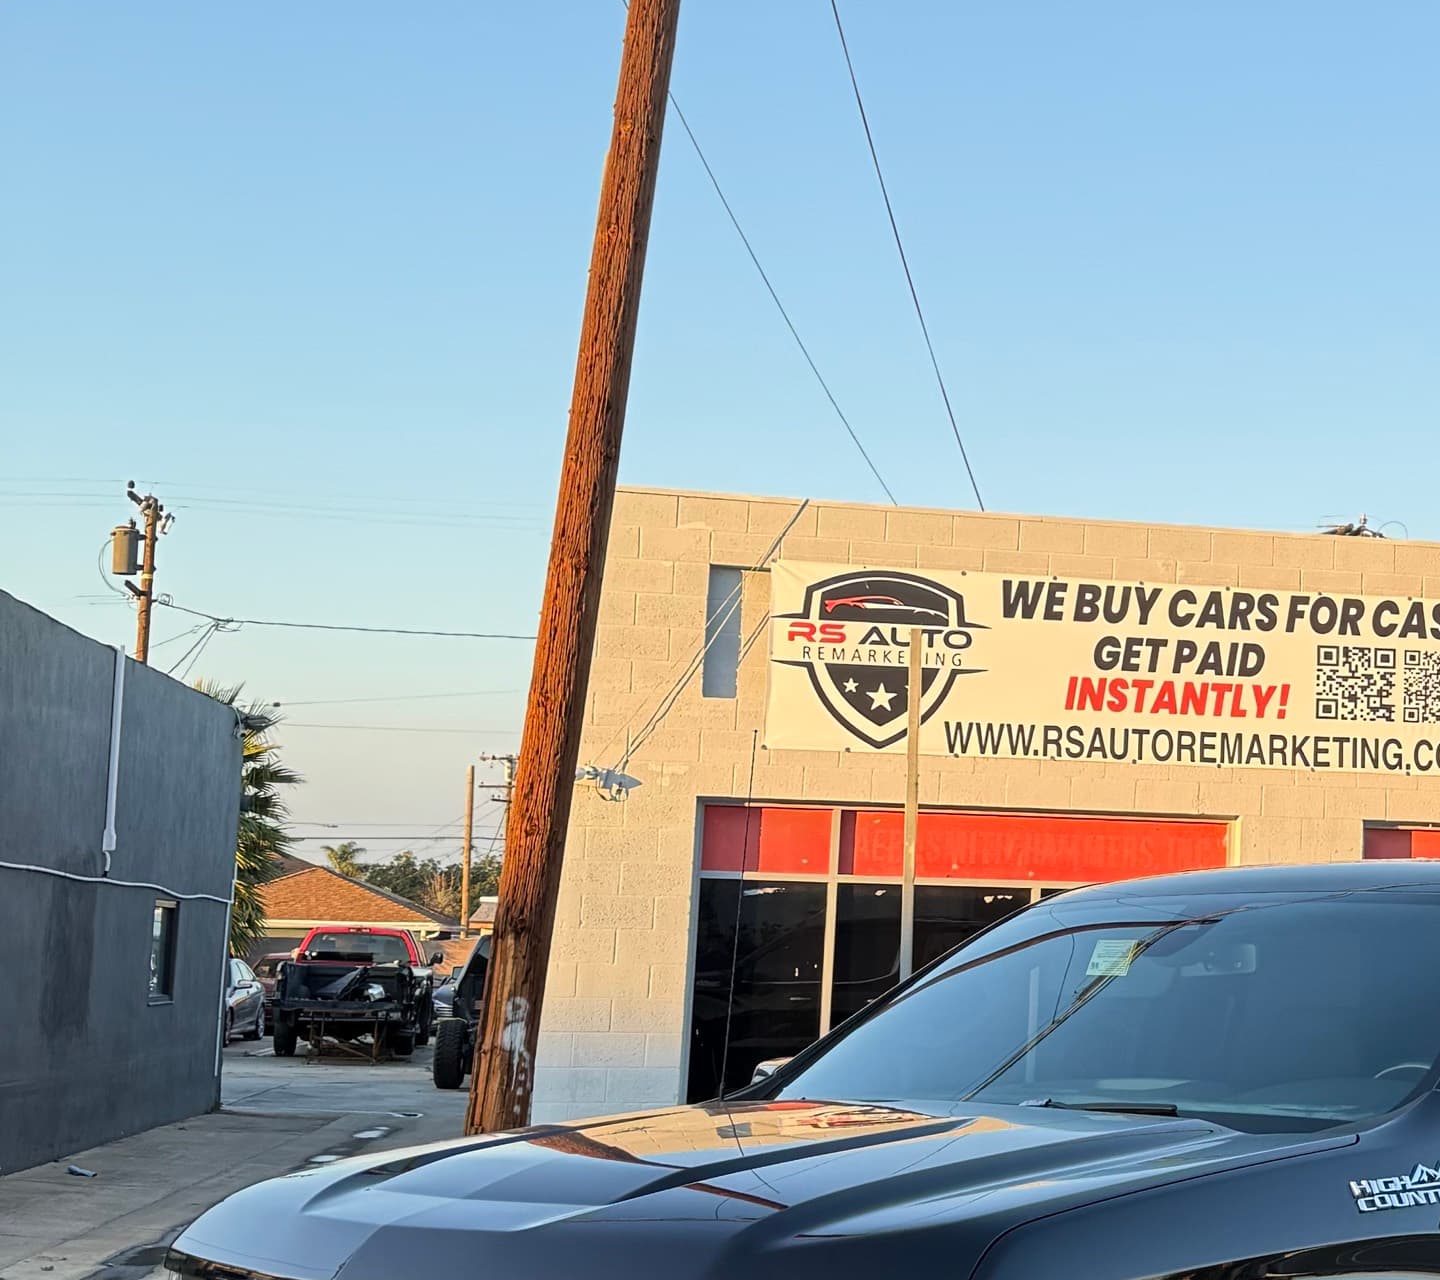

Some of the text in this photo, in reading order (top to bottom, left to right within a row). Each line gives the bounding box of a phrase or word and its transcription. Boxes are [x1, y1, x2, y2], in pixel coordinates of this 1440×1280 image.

[1002, 579, 1069, 621] WE
[1073, 583, 1163, 626] BUY
[1168, 589, 1280, 632] CARS
[1285, 595, 1365, 636] FOR
[787, 621, 973, 650] RS AUTO
[802, 645, 963, 667] REMARKEING
[1093, 635, 1266, 678] GET PAID
[1065, 676, 1291, 719] INSTANTLY!
[1349, 1175, 1414, 1197] HIGH
